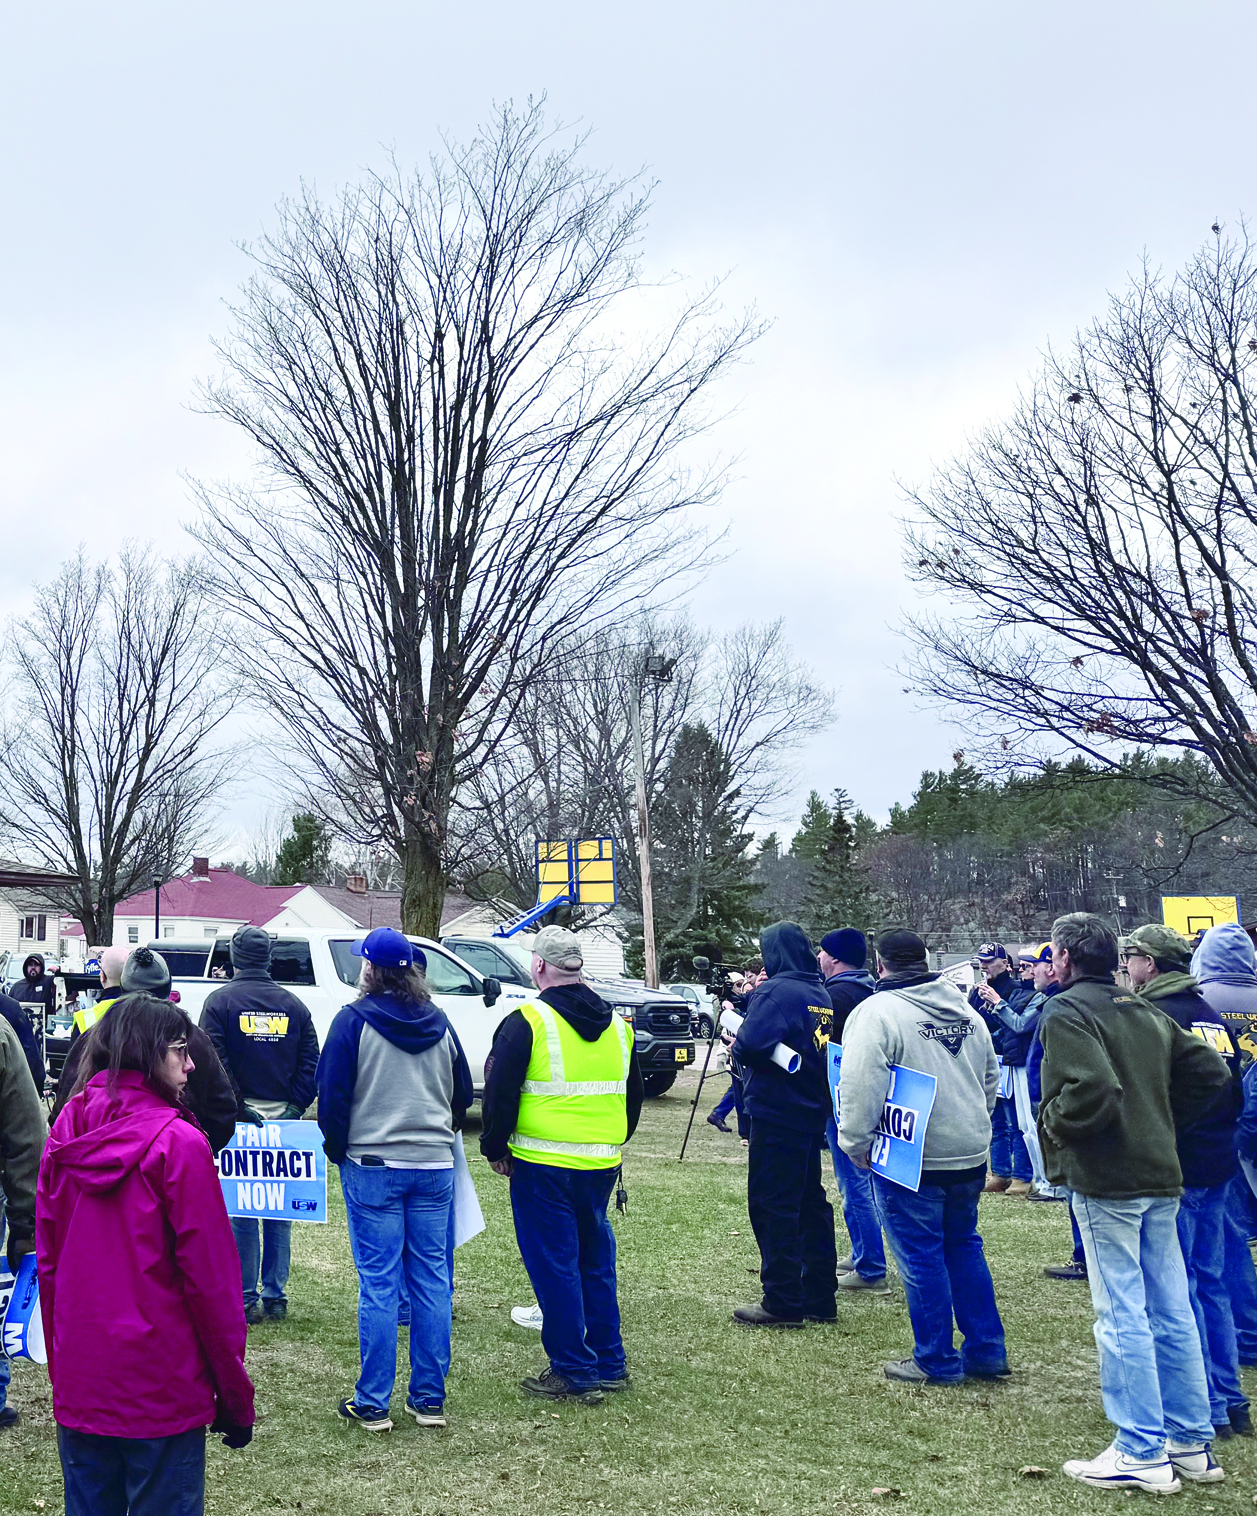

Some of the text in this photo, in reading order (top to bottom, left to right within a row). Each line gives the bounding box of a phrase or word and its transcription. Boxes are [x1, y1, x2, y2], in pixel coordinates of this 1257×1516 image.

[239, 1015, 290, 1034] USW
[921, 1025, 975, 1038] VICTORY
[236, 1124, 282, 1147] FAIR
[237, 1182, 285, 1211] NOW
[292, 1200, 317, 1211] USW
